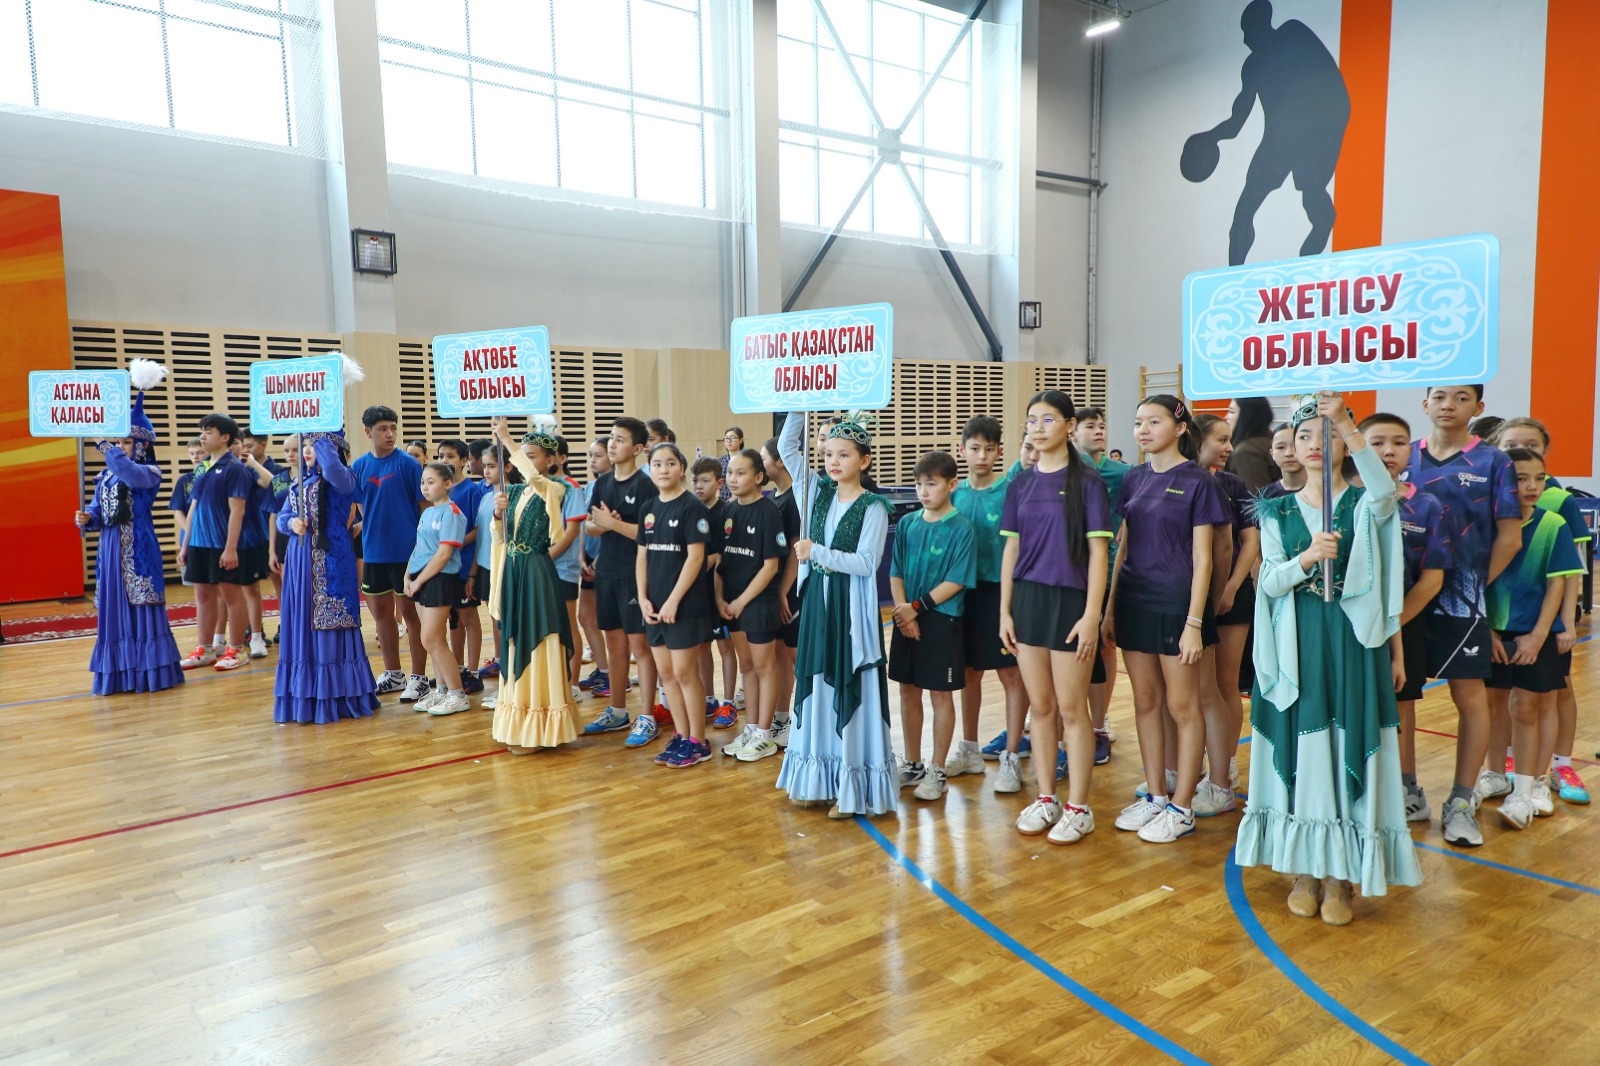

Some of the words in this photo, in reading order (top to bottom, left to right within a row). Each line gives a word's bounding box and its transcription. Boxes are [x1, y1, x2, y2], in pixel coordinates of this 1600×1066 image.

[1257, 272, 1403, 324] ЖЕТІСУ
[744, 331, 788, 361] БАТЫС
[791, 324, 875, 361] ҚАЗАҚСТАН
[1242, 321, 1419, 372] ОБЛЫСЫ
[462, 345, 518, 373] АҚТӨБЕ
[53, 382, 101, 401] АСТАНА
[264, 371, 327, 396] ШЫМКЕНТ
[459, 375, 527, 401] ОБЛЫСЫ
[774, 363, 837, 393] ОБЛЫСЫ
[51, 406, 104, 425] ҚАЛАСЫ
[270, 398, 321, 422] ҚАЛАСЫ
